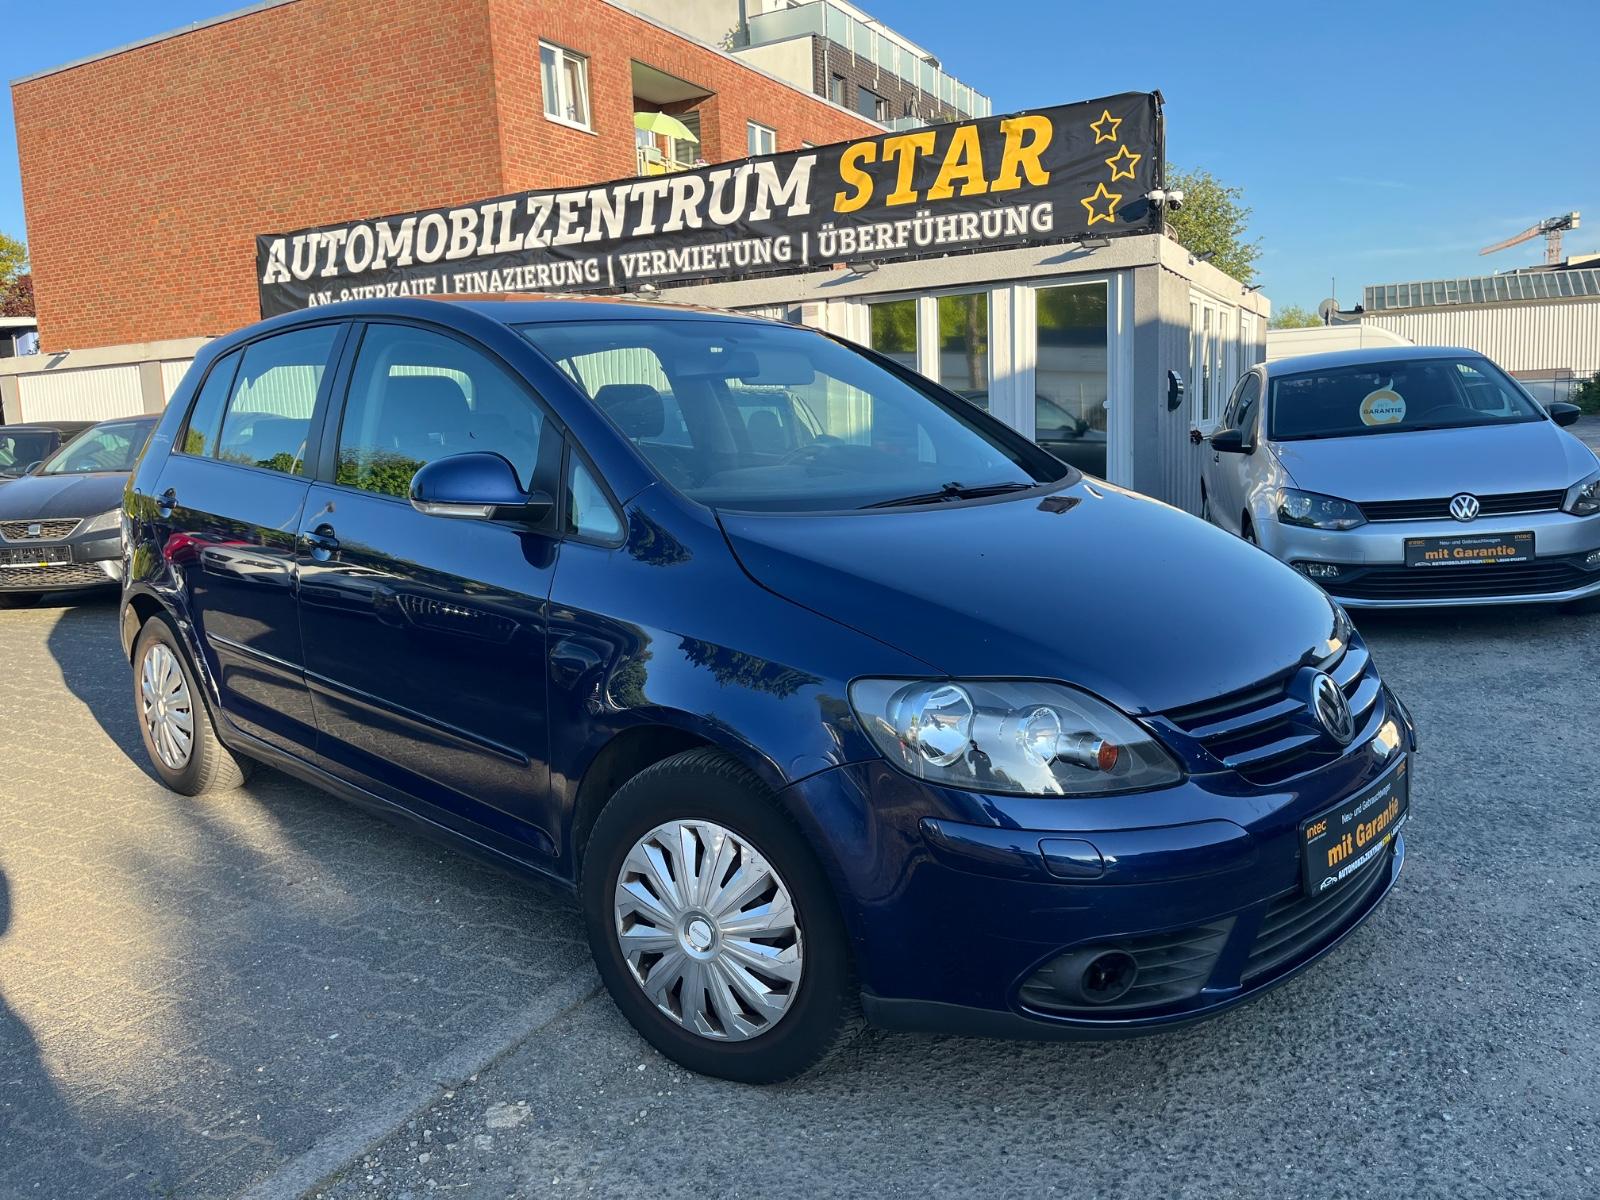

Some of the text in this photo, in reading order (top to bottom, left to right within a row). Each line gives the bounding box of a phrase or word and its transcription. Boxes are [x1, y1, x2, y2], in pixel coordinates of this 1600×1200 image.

[263, 115, 1053, 284] AUTOMOBILZENTRUM STAR
[453, 258, 601, 293] FINAZIERUNG
[620, 235, 792, 278] VERMIETUNG
[817, 203, 1054, 258] ÜBERFÜHRUNG
[1363, 407, 1402, 415] GARANTIE
[1425, 545, 1516, 560] mit Garantie
[1327, 832, 1354, 868] mit
[1356, 796, 1399, 848] Garantie
